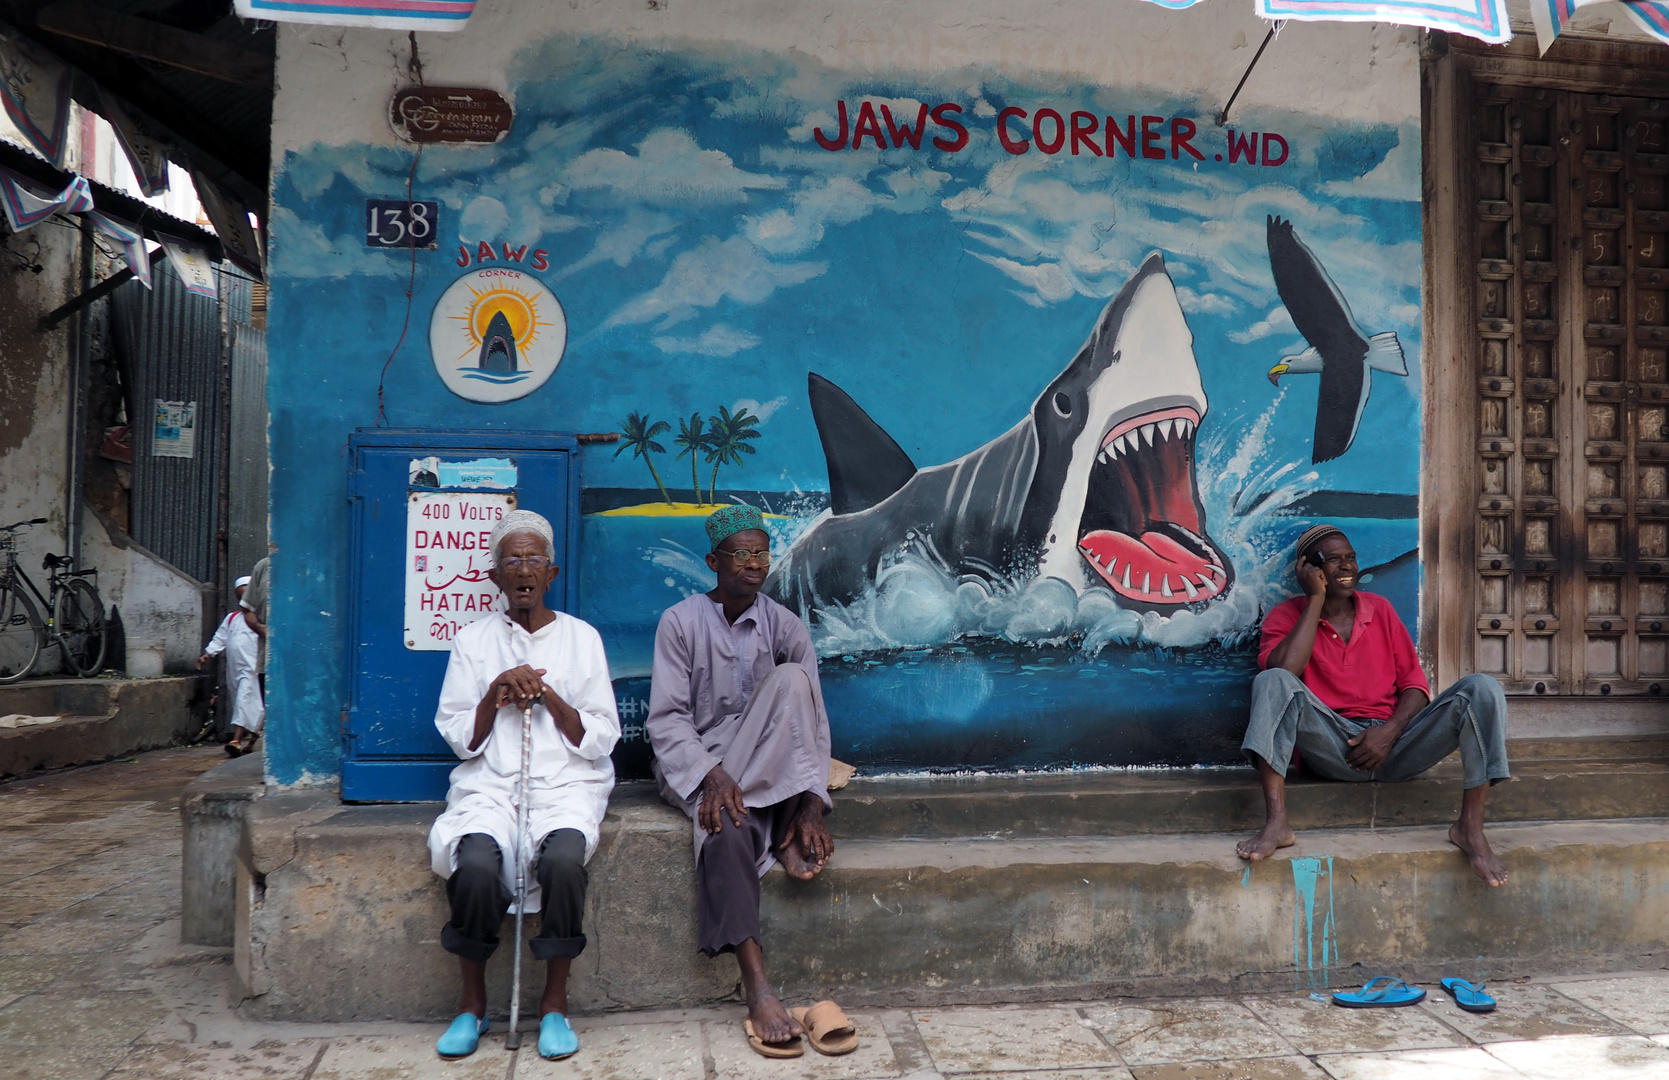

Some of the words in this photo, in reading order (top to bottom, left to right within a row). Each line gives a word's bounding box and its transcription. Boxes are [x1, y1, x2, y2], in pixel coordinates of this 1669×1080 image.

[813, 100, 969, 152] JAWS
[367, 202, 430, 244] 138
[457, 240, 549, 272] JAWS
[1592, 232, 1605, 261] 5
[479, 269, 521, 280] CORNER
[422, 503, 450, 519] 400
[459, 502, 503, 521] VOLTS
[415, 530, 492, 549] DANGE
